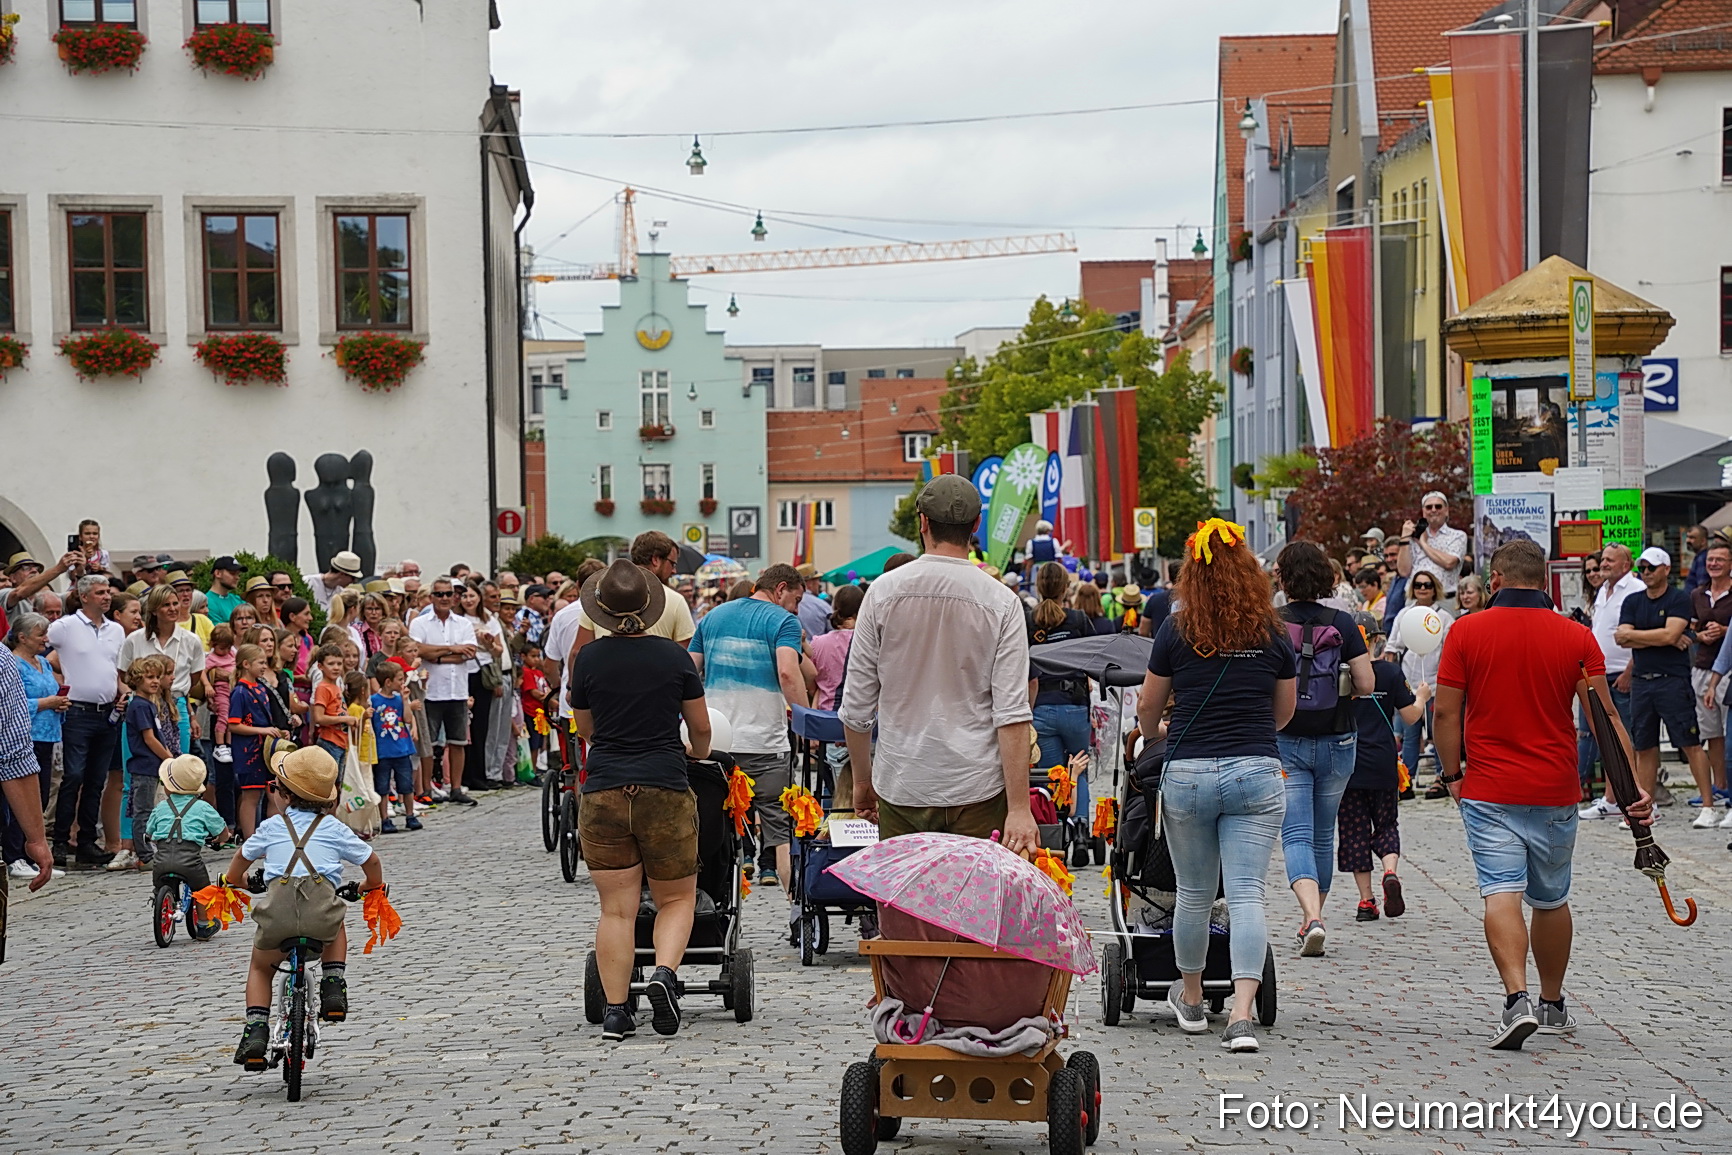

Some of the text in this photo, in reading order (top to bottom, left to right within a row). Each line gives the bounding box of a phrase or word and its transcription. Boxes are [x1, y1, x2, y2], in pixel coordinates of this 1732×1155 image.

[1485, 498, 1527, 507] FELSENFEST
[1488, 506, 1545, 515] DEINSCHWANG
[1602, 515, 1632, 526] JURA-
[1602, 528, 1641, 539] LKSFEST
